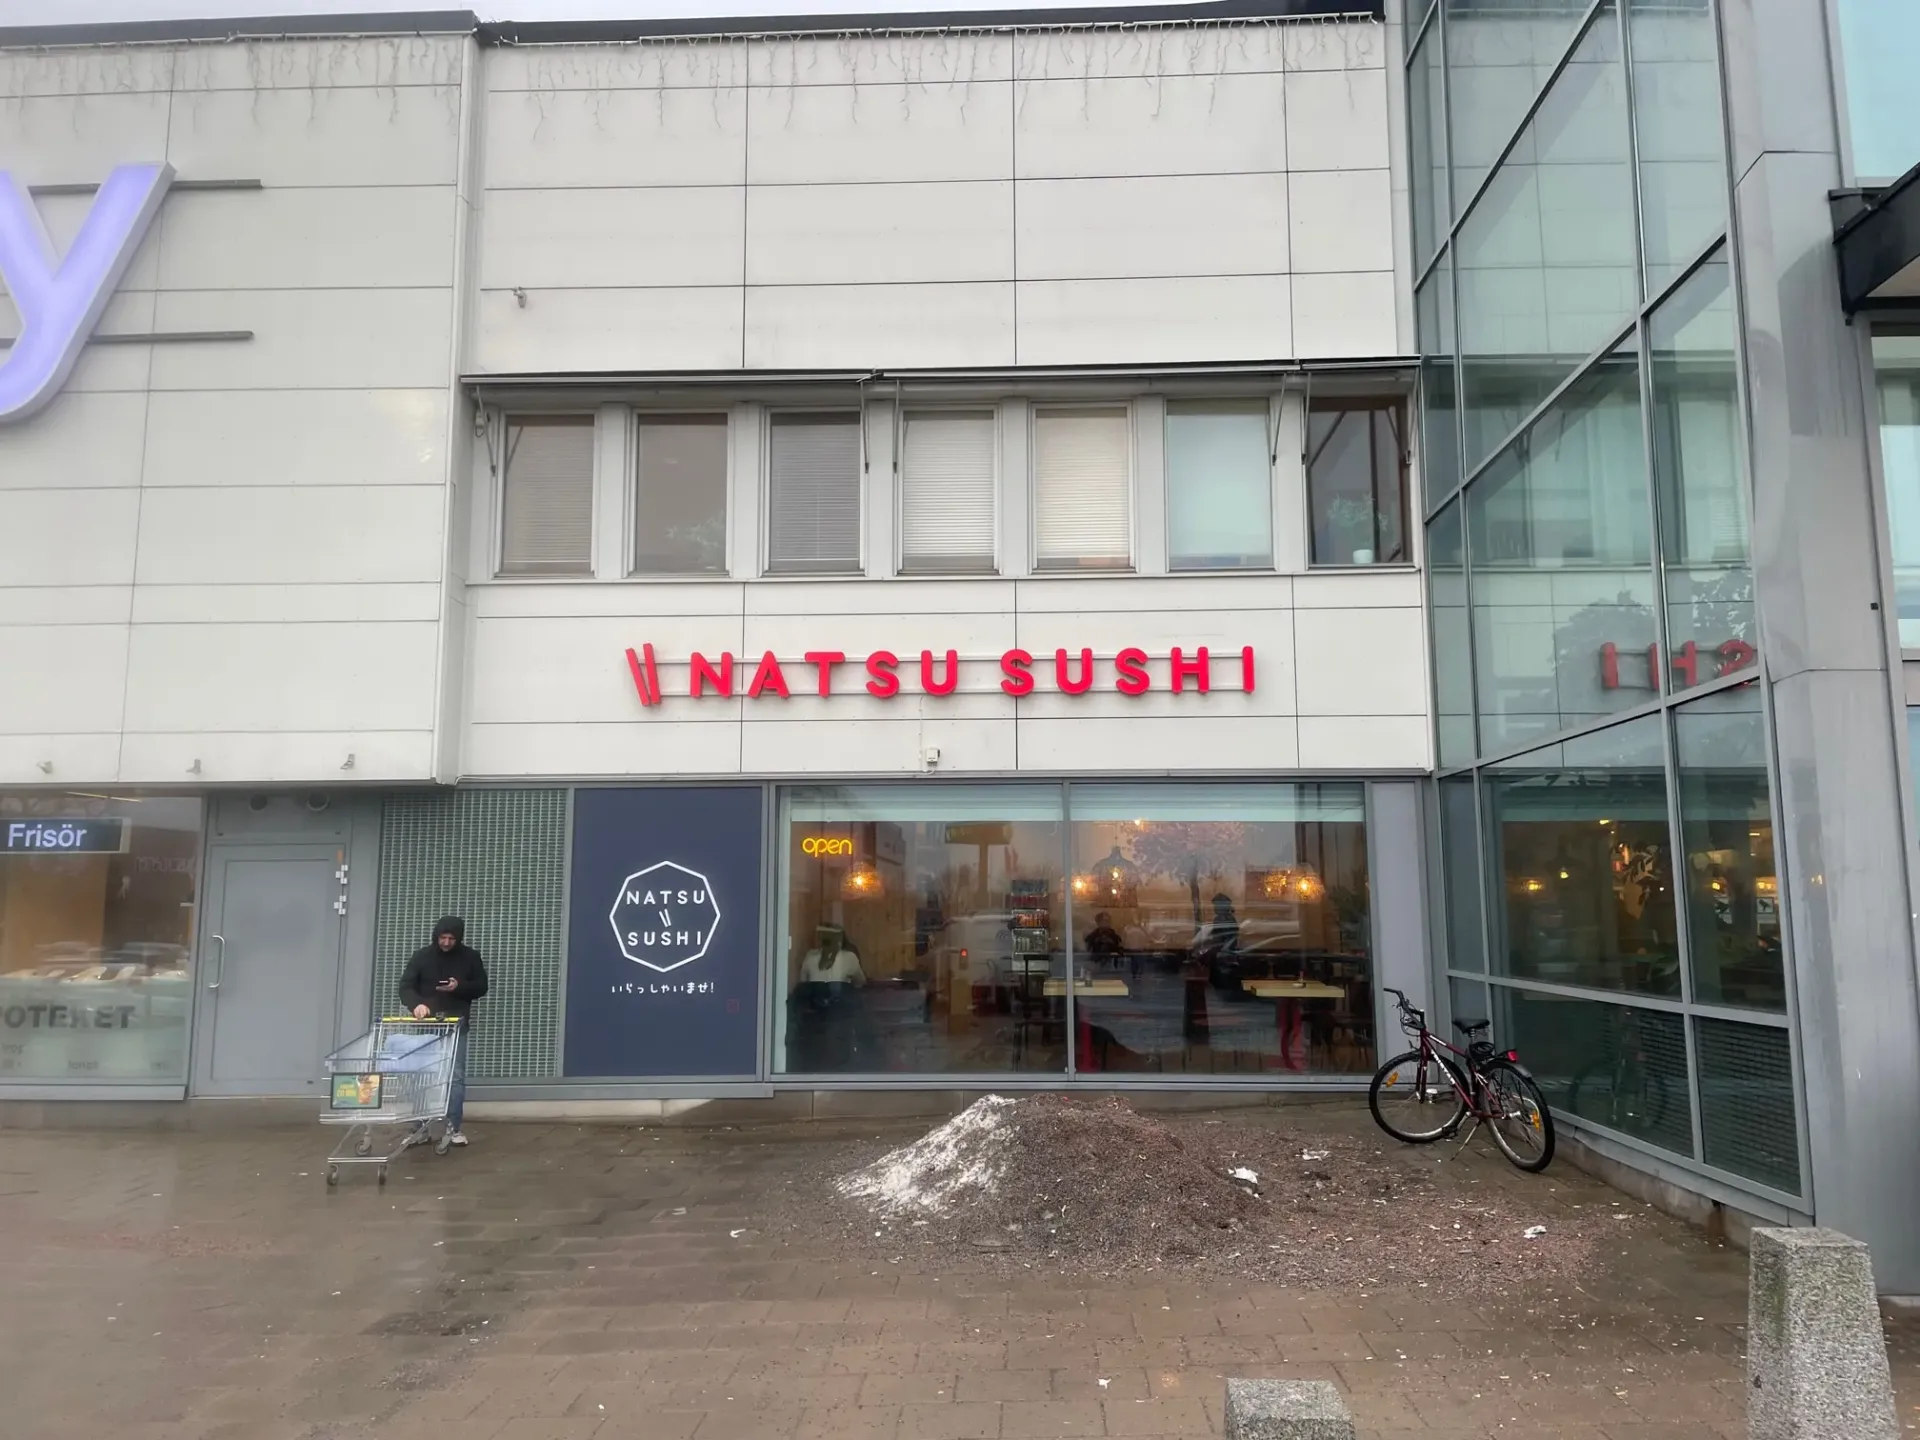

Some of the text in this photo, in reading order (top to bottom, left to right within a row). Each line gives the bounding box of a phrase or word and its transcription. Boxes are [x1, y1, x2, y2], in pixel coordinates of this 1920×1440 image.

[0, 161, 178, 421] y
[690, 646, 1255, 698] NATSU SUSHI
[8, 823, 88, 848] Frisör
[802, 837, 853, 858] open
[626, 890, 705, 905] NATSU
[627, 931, 702, 946] SUSHI
[0, 1004, 136, 1029] OTEKET
